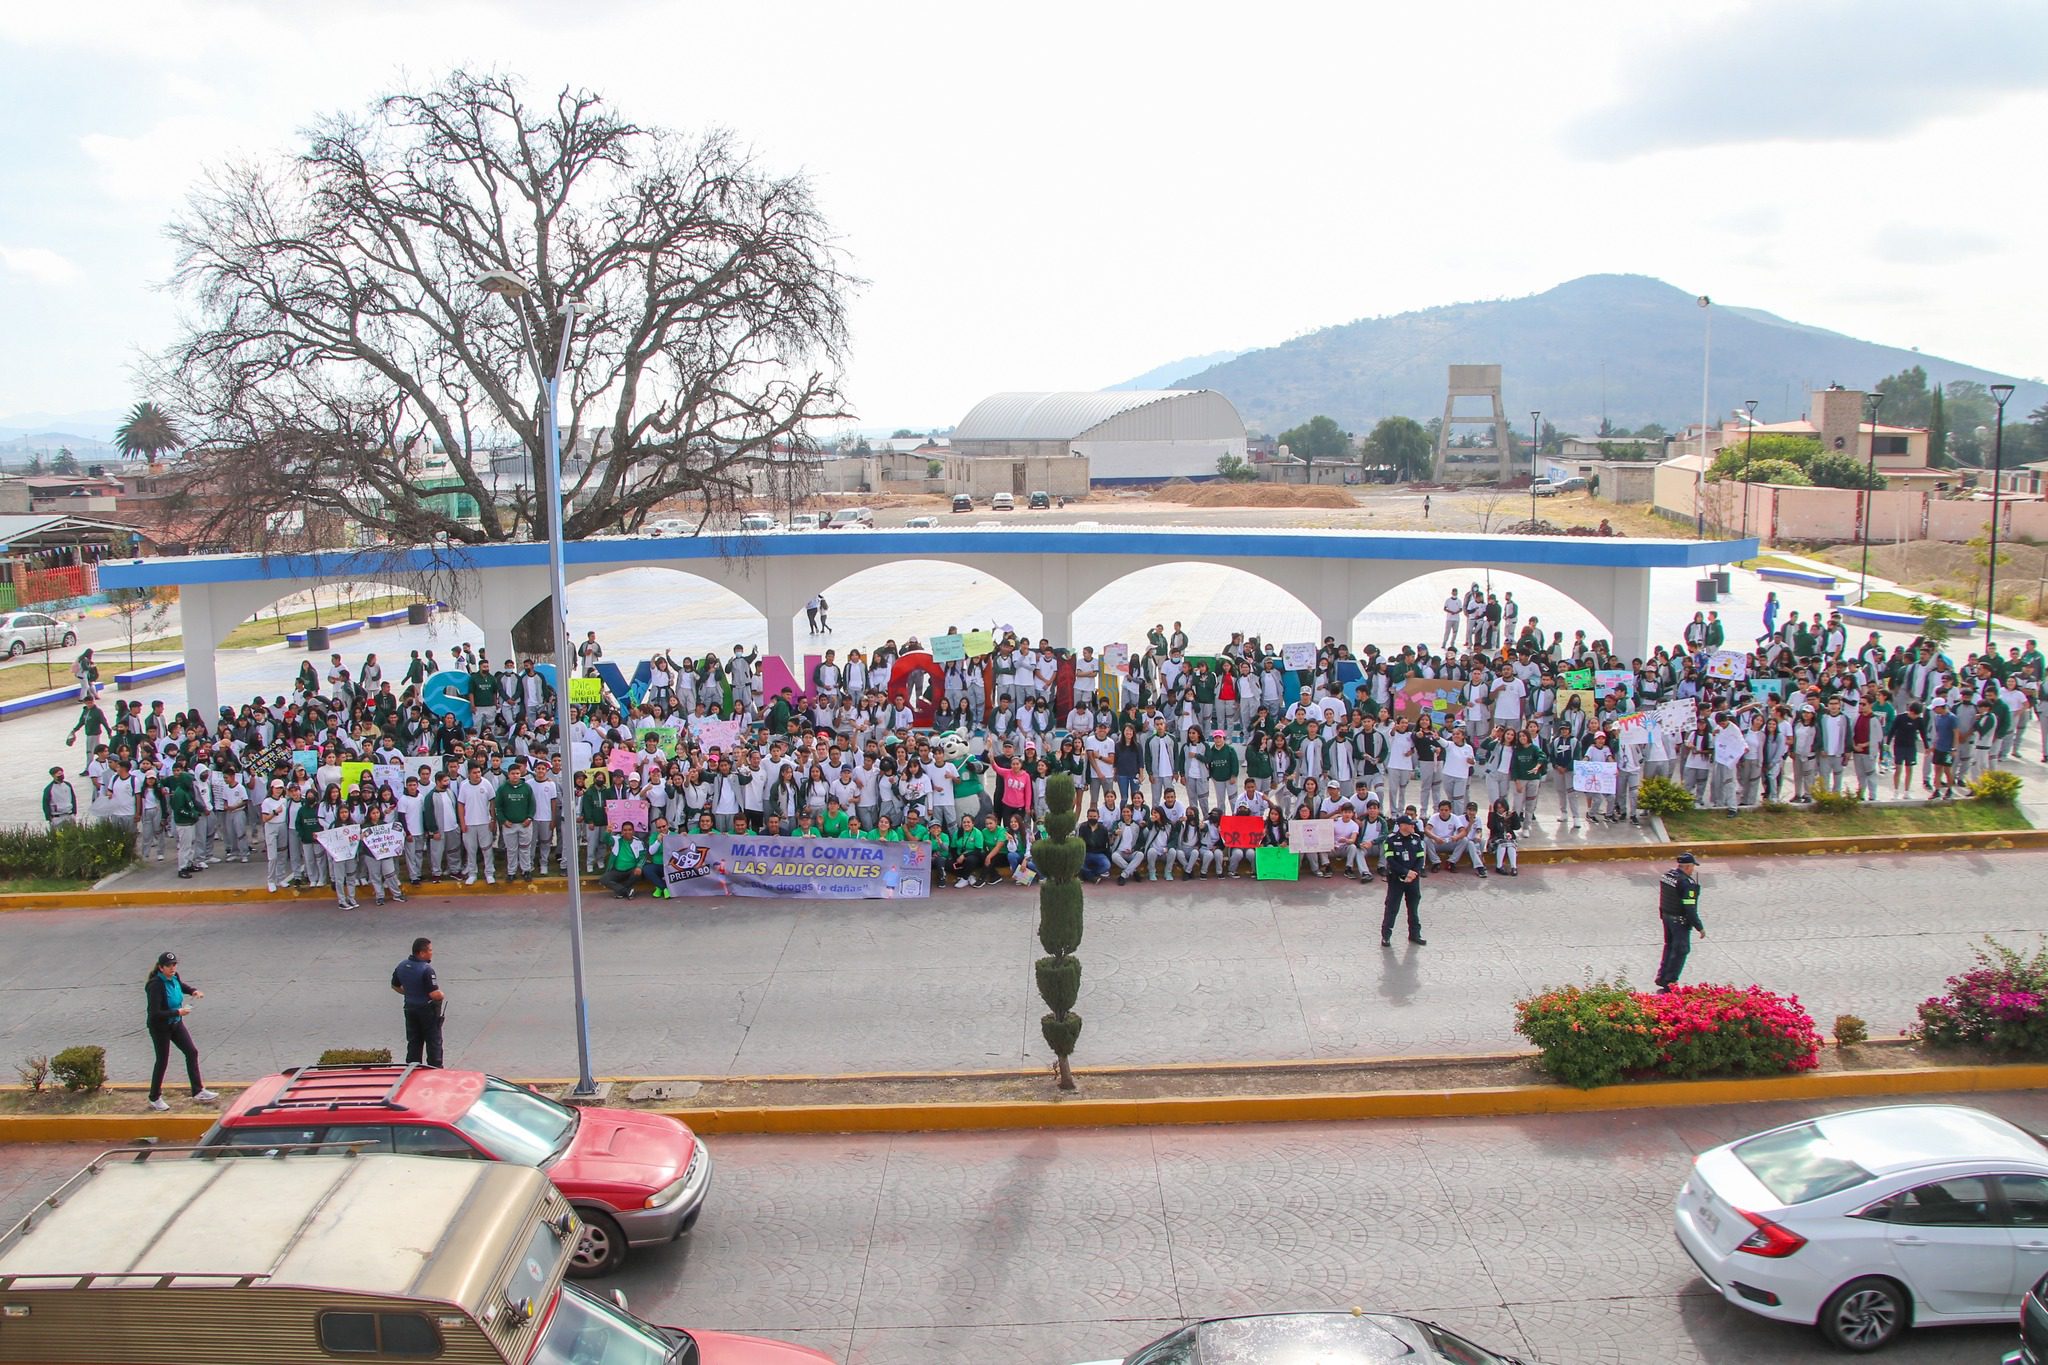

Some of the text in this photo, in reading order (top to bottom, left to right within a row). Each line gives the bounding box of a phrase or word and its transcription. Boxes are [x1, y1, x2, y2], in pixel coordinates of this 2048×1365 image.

[731, 844, 884, 860] MARCHA CONTRA
[669, 866, 710, 882] PREPA 80
[732, 861, 881, 878] LAS ADICCIONES
[776, 881, 813, 893] drogas
